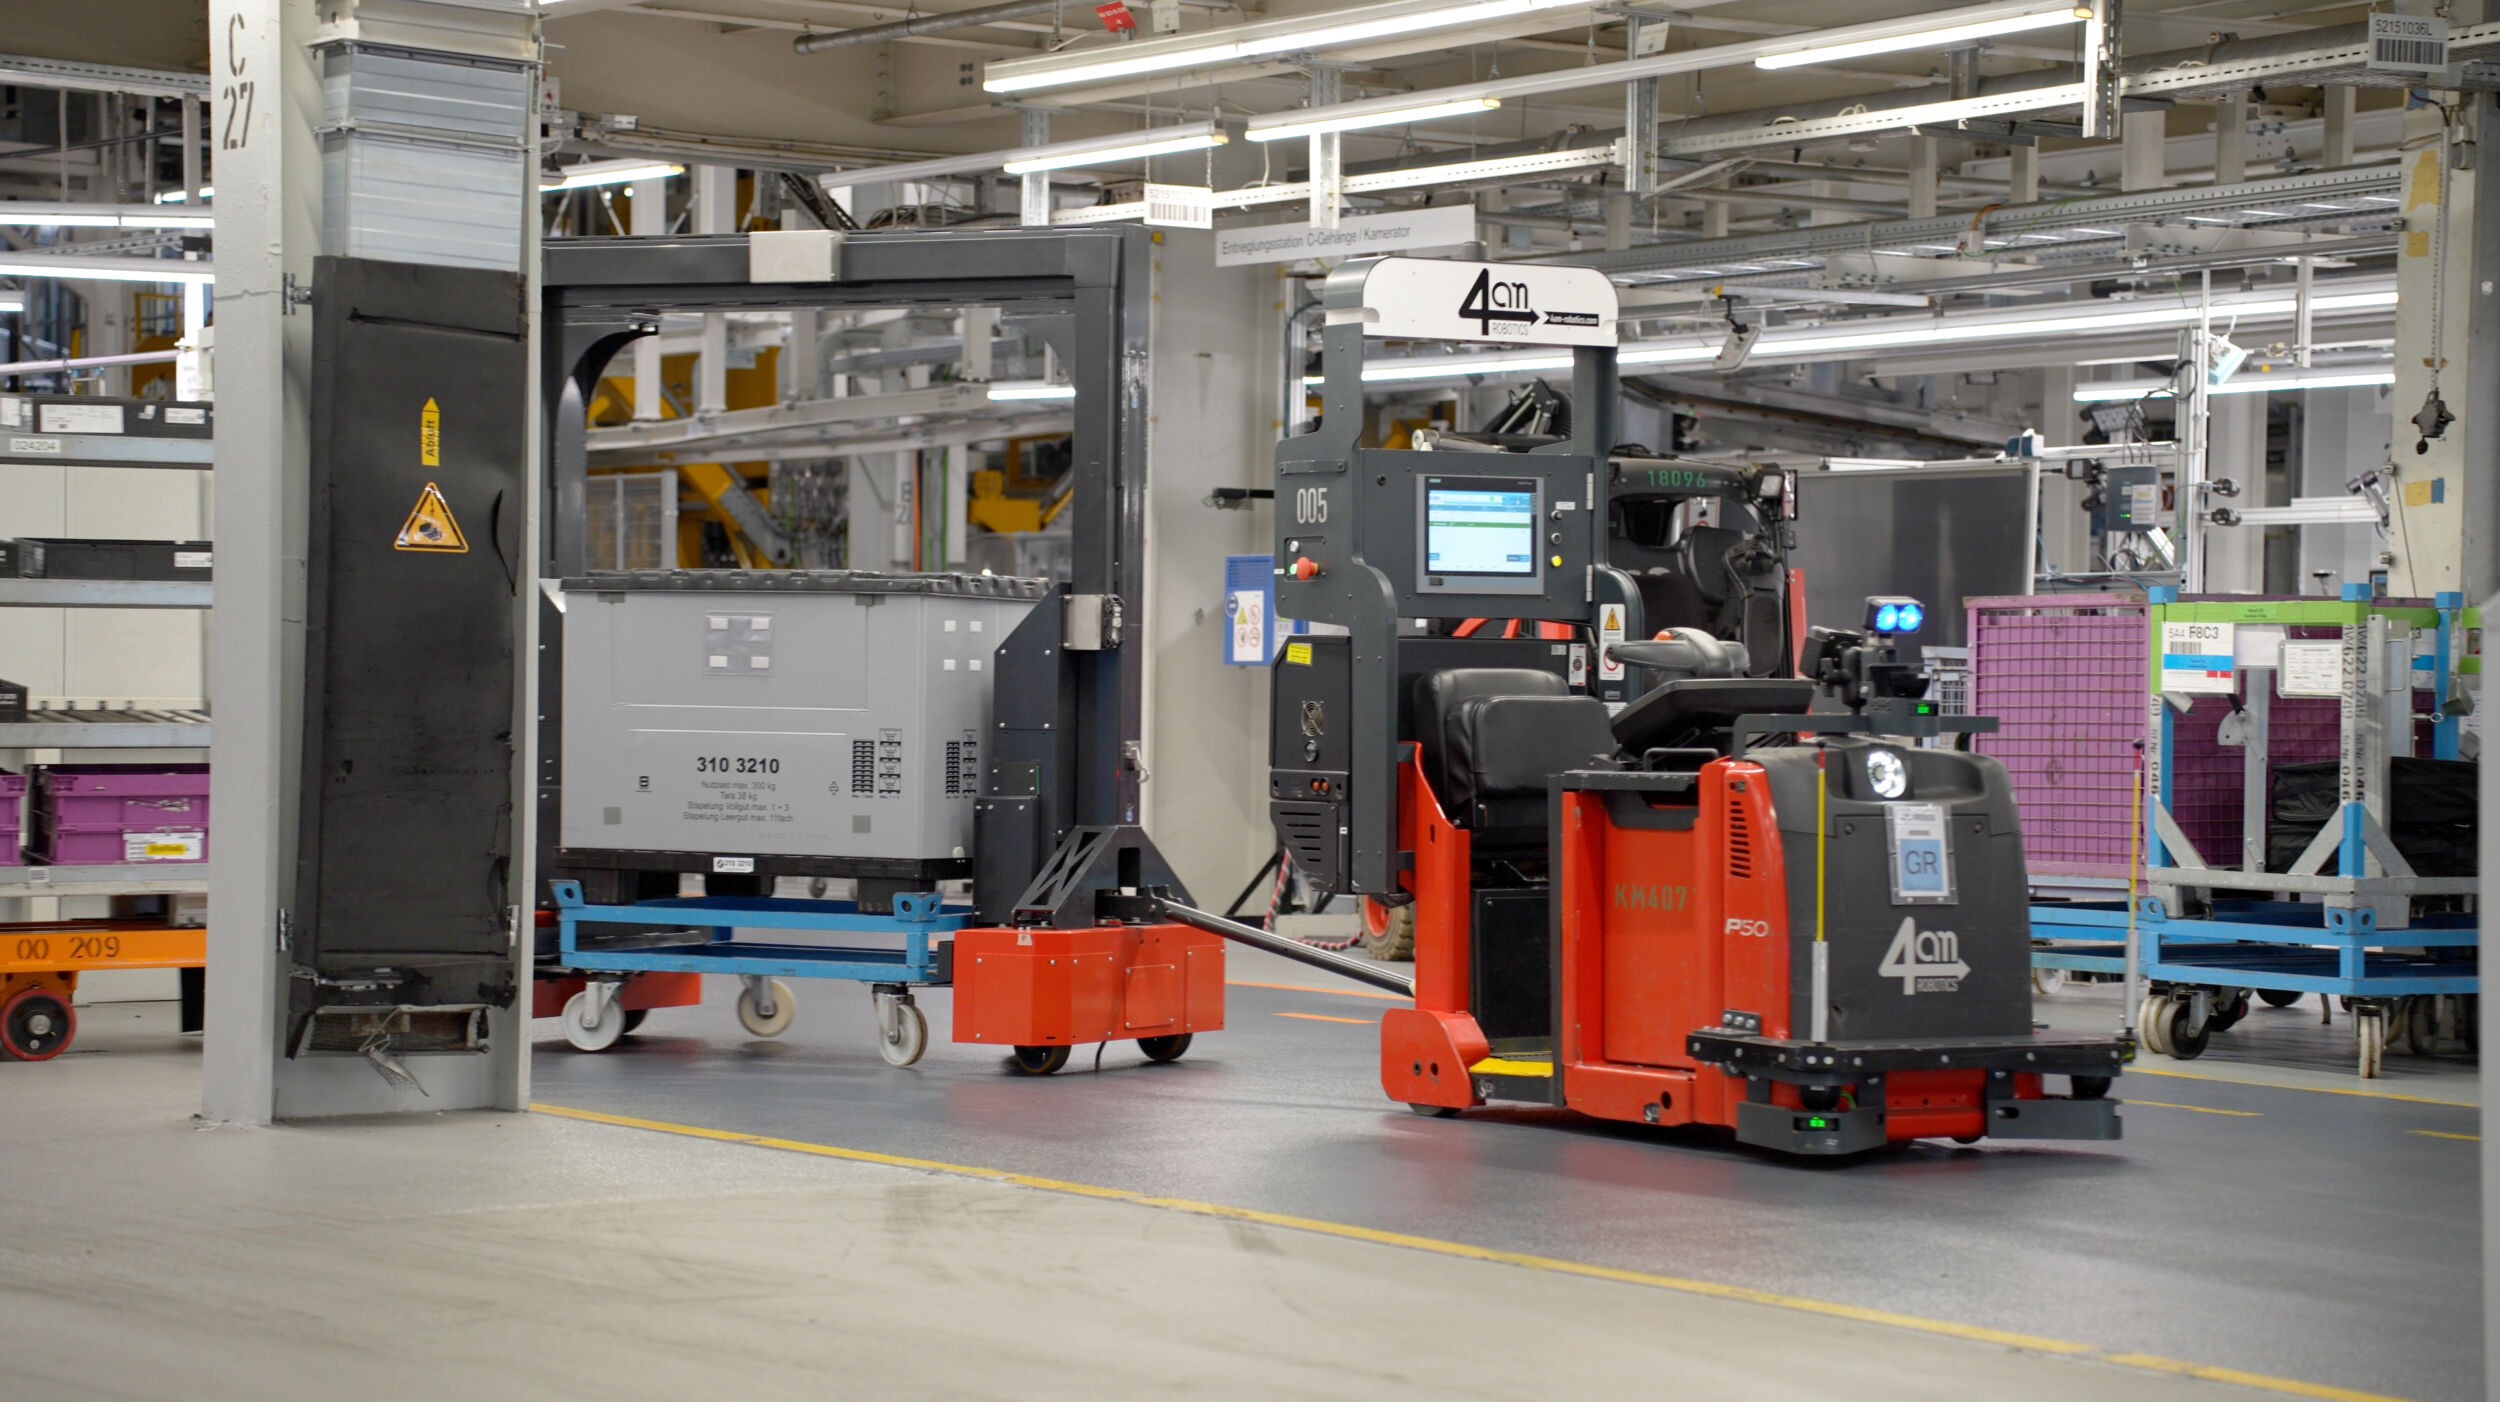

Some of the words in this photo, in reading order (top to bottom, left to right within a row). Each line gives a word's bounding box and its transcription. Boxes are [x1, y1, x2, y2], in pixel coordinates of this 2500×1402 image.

[228, 12, 246, 77] C
[223, 81, 254, 150] 27
[1492, 322, 1529, 336] ROBOTICS
[1647, 469, 1706, 488] 18096
[1296, 487, 1328, 524] 005
[2189, 626, 2219, 639] F8C3
[696, 756, 729, 772] 310
[736, 757, 780, 774] 3210
[701, 780, 731, 789] Nutzlast
[767, 782, 776, 791] kg
[687, 801, 724, 812] Stapelung
[748, 792, 758, 802] kg
[1905, 850, 1938, 875] GR
[1615, 883, 1697, 911] KM407
[1724, 918, 1769, 937] P50
[16, 938, 49, 960] 00
[69, 936, 120, 958] 209
